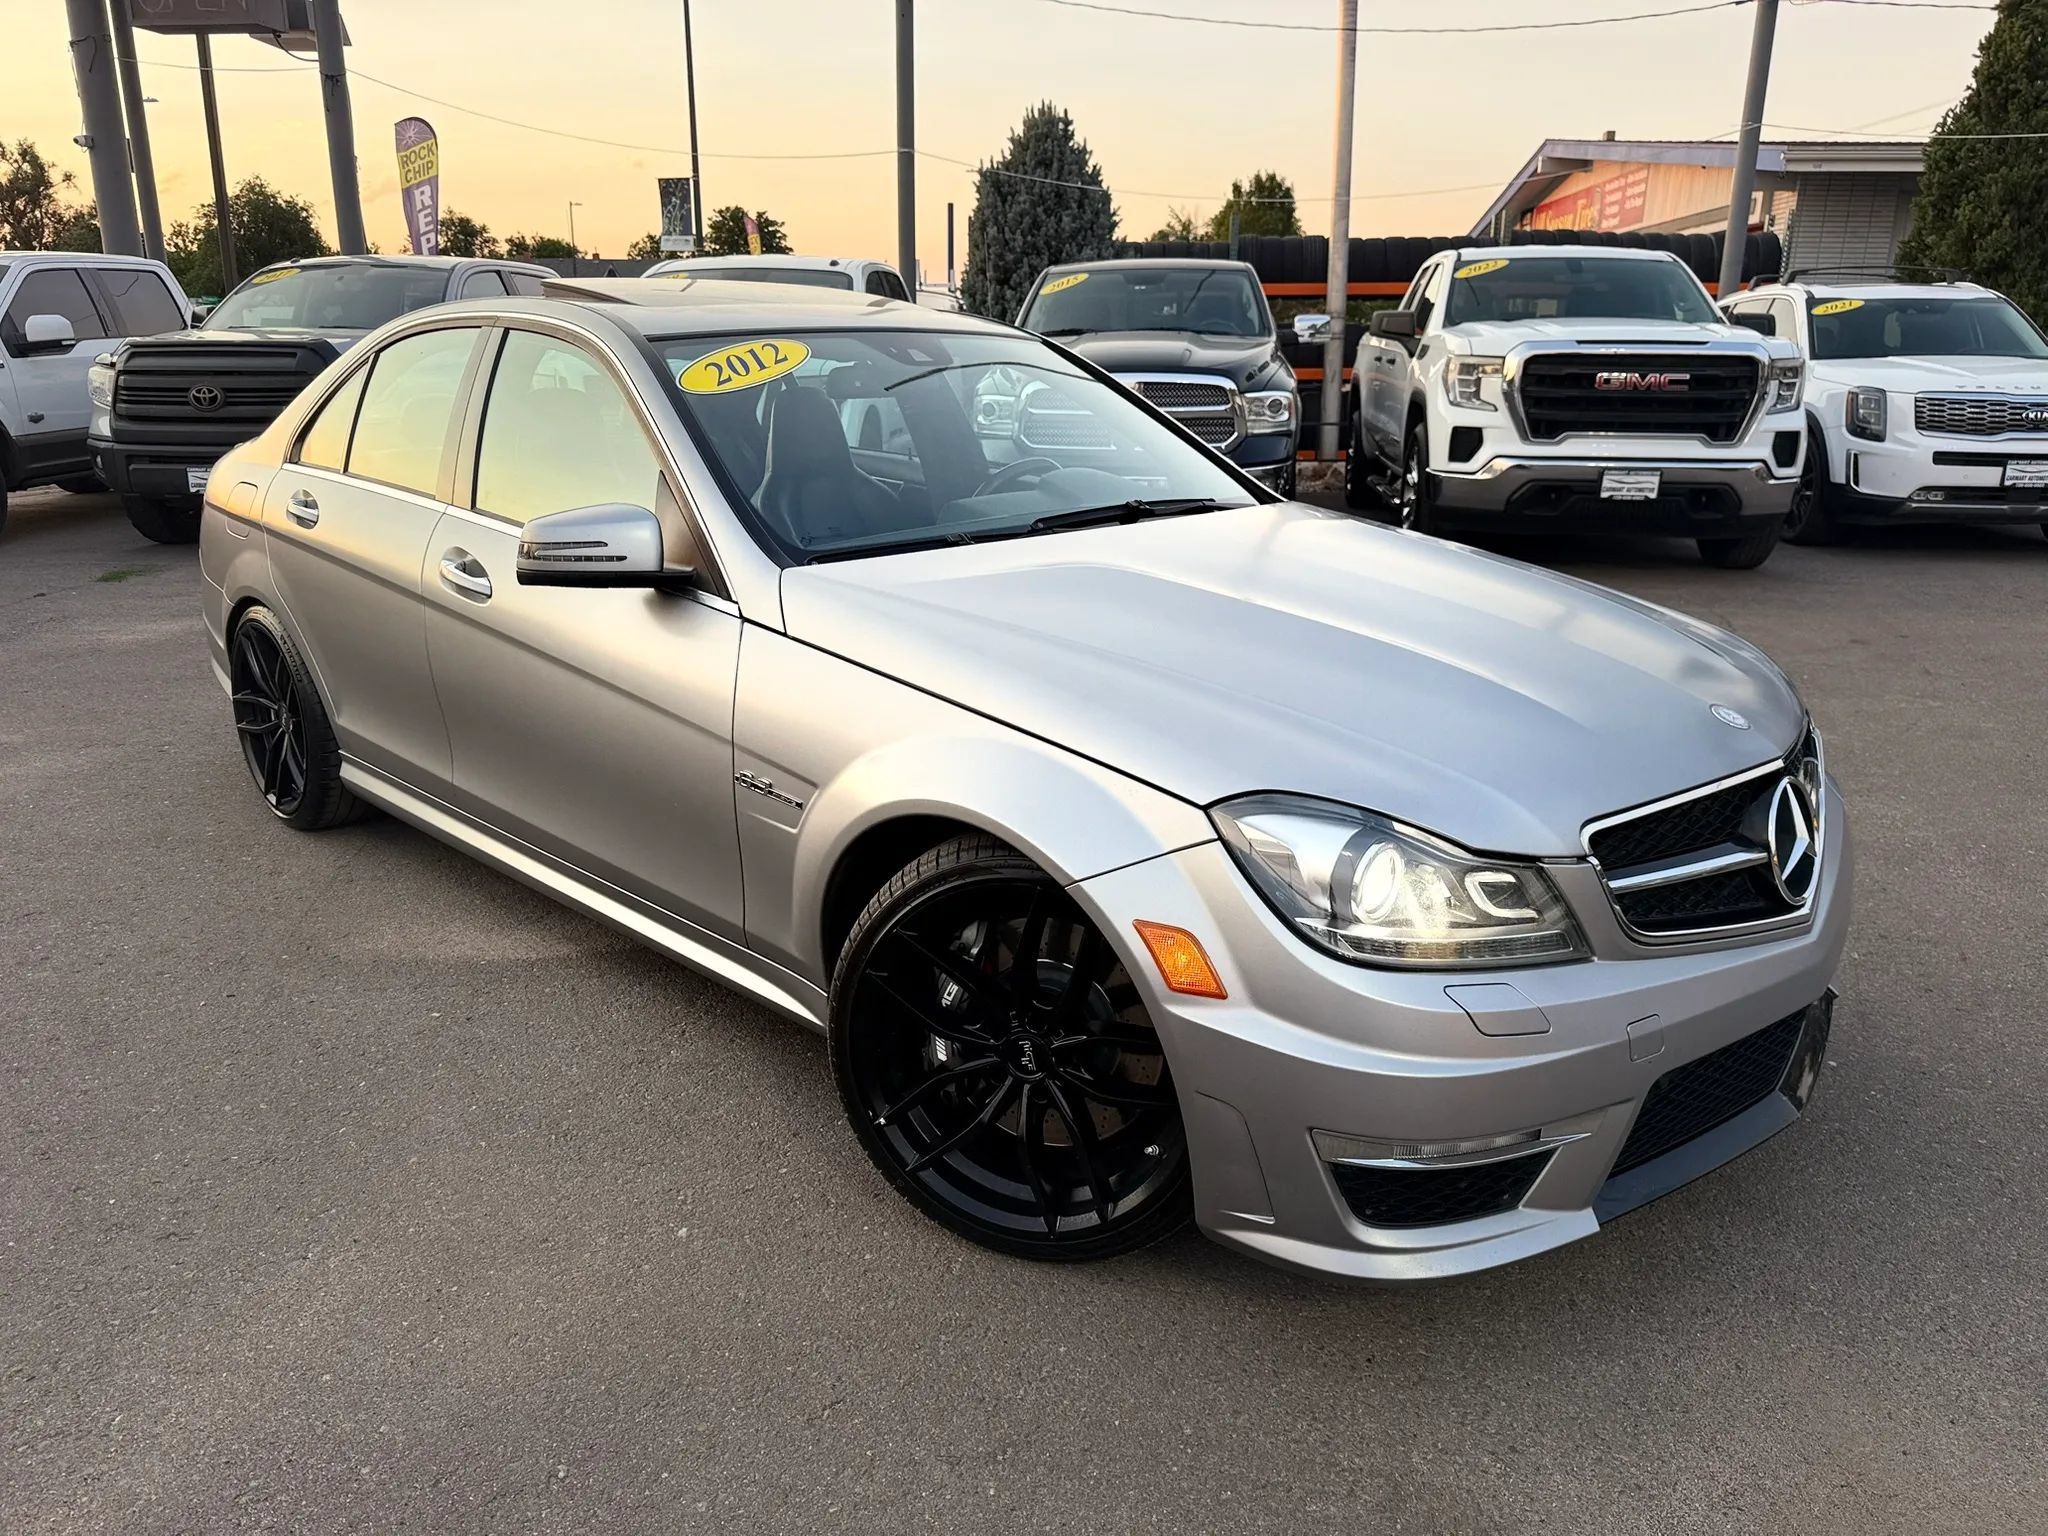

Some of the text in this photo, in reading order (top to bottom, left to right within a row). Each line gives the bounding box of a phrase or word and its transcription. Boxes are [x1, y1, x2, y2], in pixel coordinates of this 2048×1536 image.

[400, 142, 435, 169] ROCK
[404, 160, 434, 183] CHIP
[1465, 261, 1498, 276] 2022
[1823, 301, 1853, 313] 2021
[704, 343, 788, 387] 2012
[1595, 373, 1690, 391] GMC
